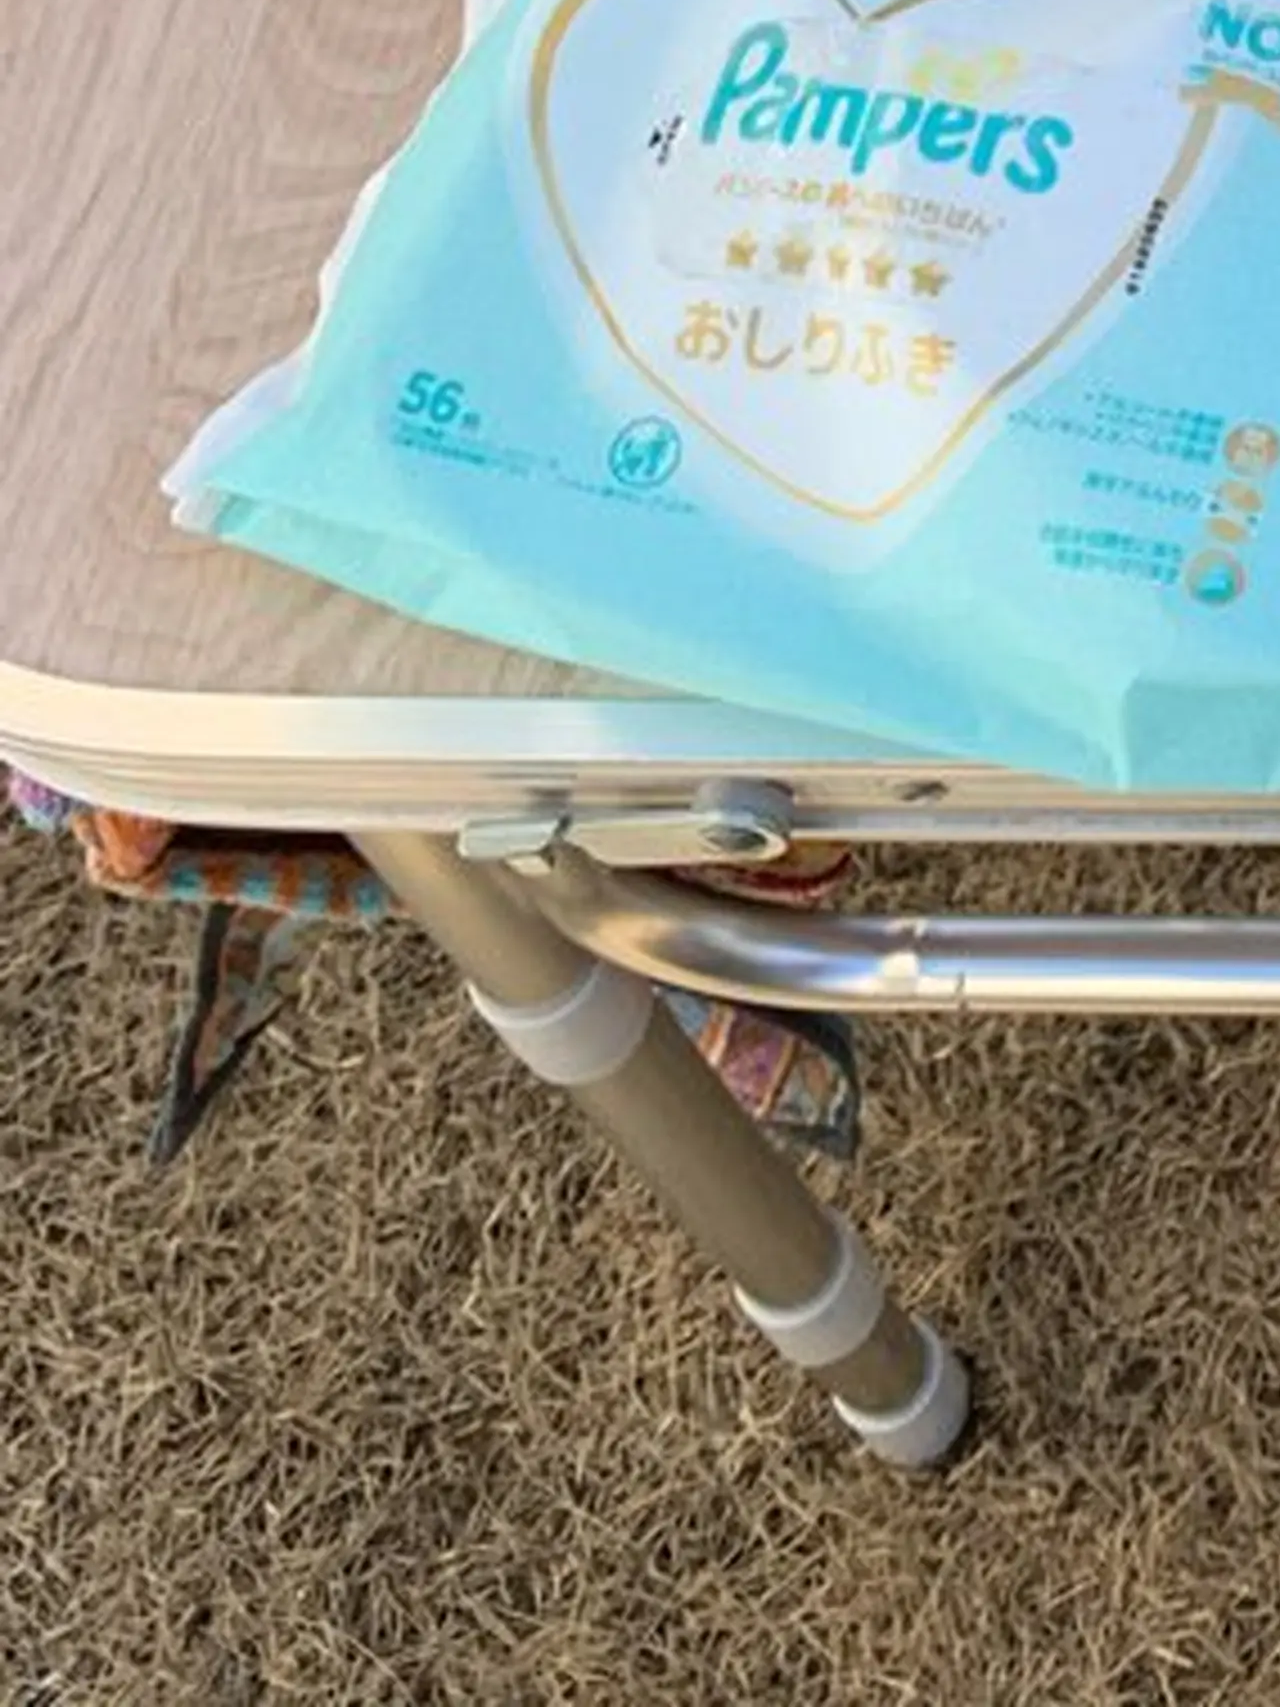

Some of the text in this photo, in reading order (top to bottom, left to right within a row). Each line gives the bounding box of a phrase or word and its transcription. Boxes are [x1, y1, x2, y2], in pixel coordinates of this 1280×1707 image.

[701, 20, 1074, 193] Pampers
[675, 300, 956, 395] おしりふき
